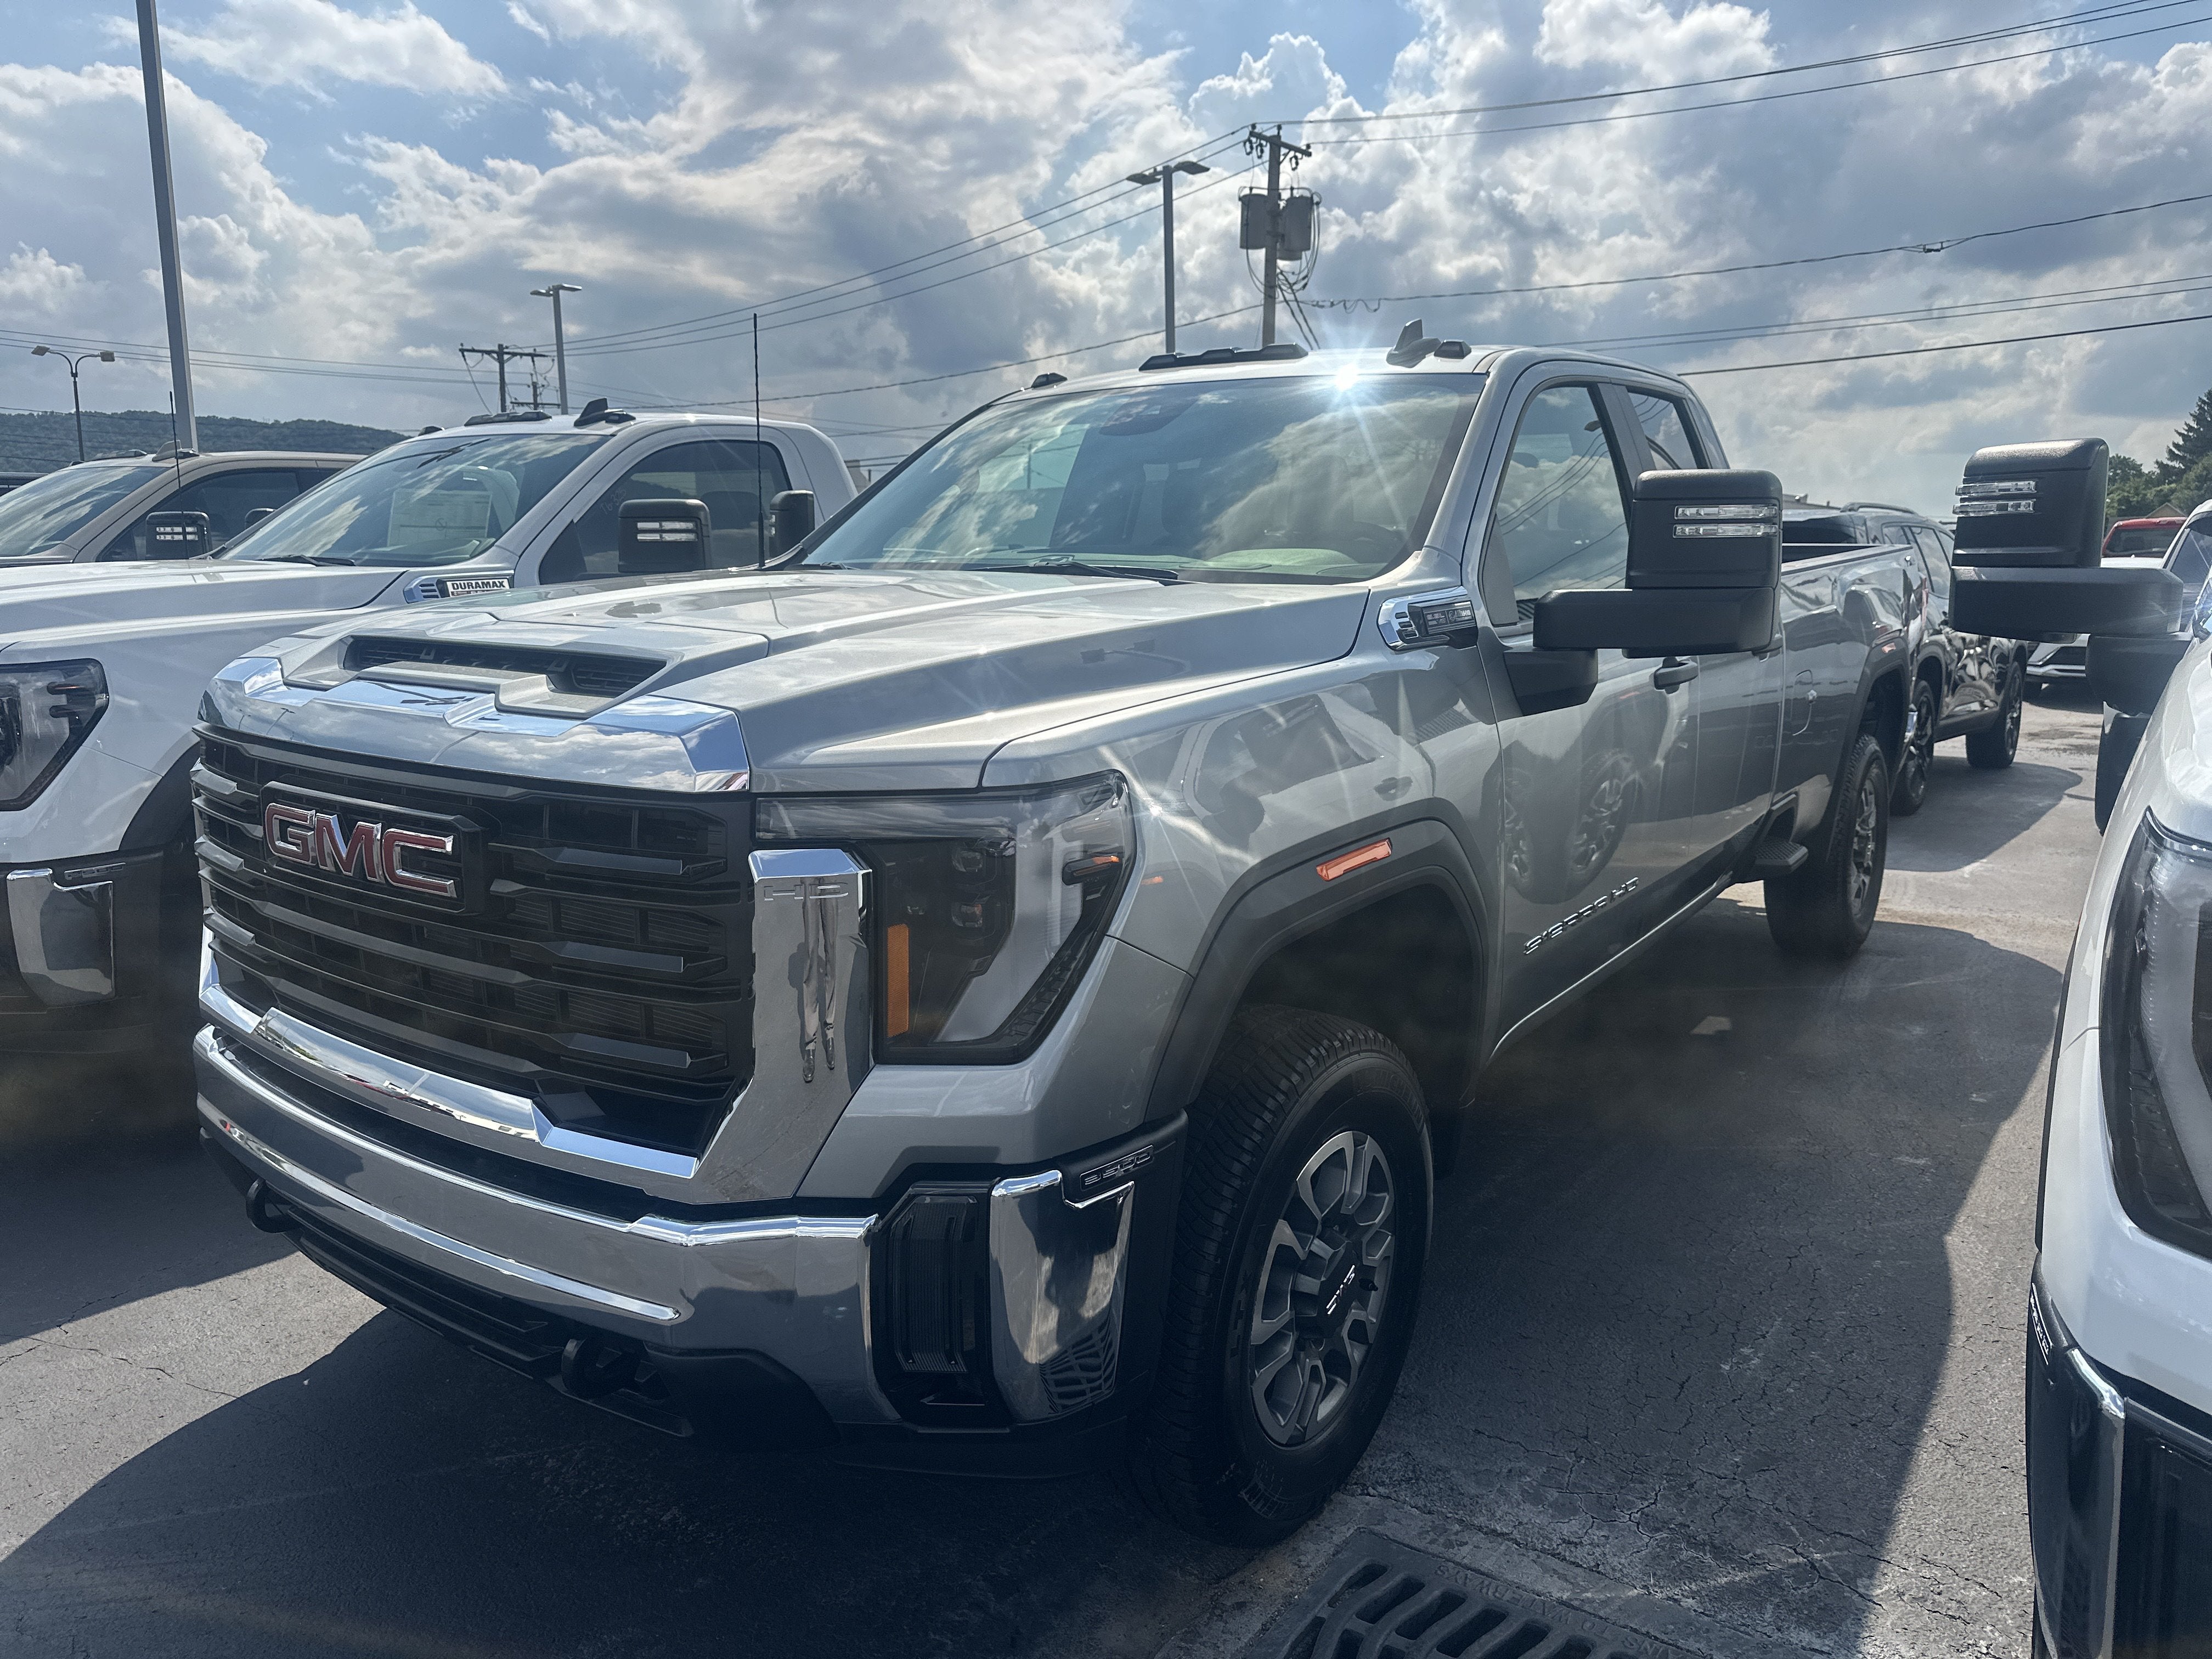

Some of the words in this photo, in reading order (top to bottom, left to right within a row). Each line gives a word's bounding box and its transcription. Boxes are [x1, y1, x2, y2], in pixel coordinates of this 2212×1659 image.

[450, 580, 506, 590] DURAMAX
[264, 802, 458, 898] GMC
[764, 882, 849, 901] HD
[1523, 895, 1609, 955] SIERRA
[1609, 876, 1639, 904] HD
[1083, 1150, 1152, 1186] 3500
[1434, 1564, 1573, 1626] WATERWAYS
[1581, 1620, 1612, 1640] TO
